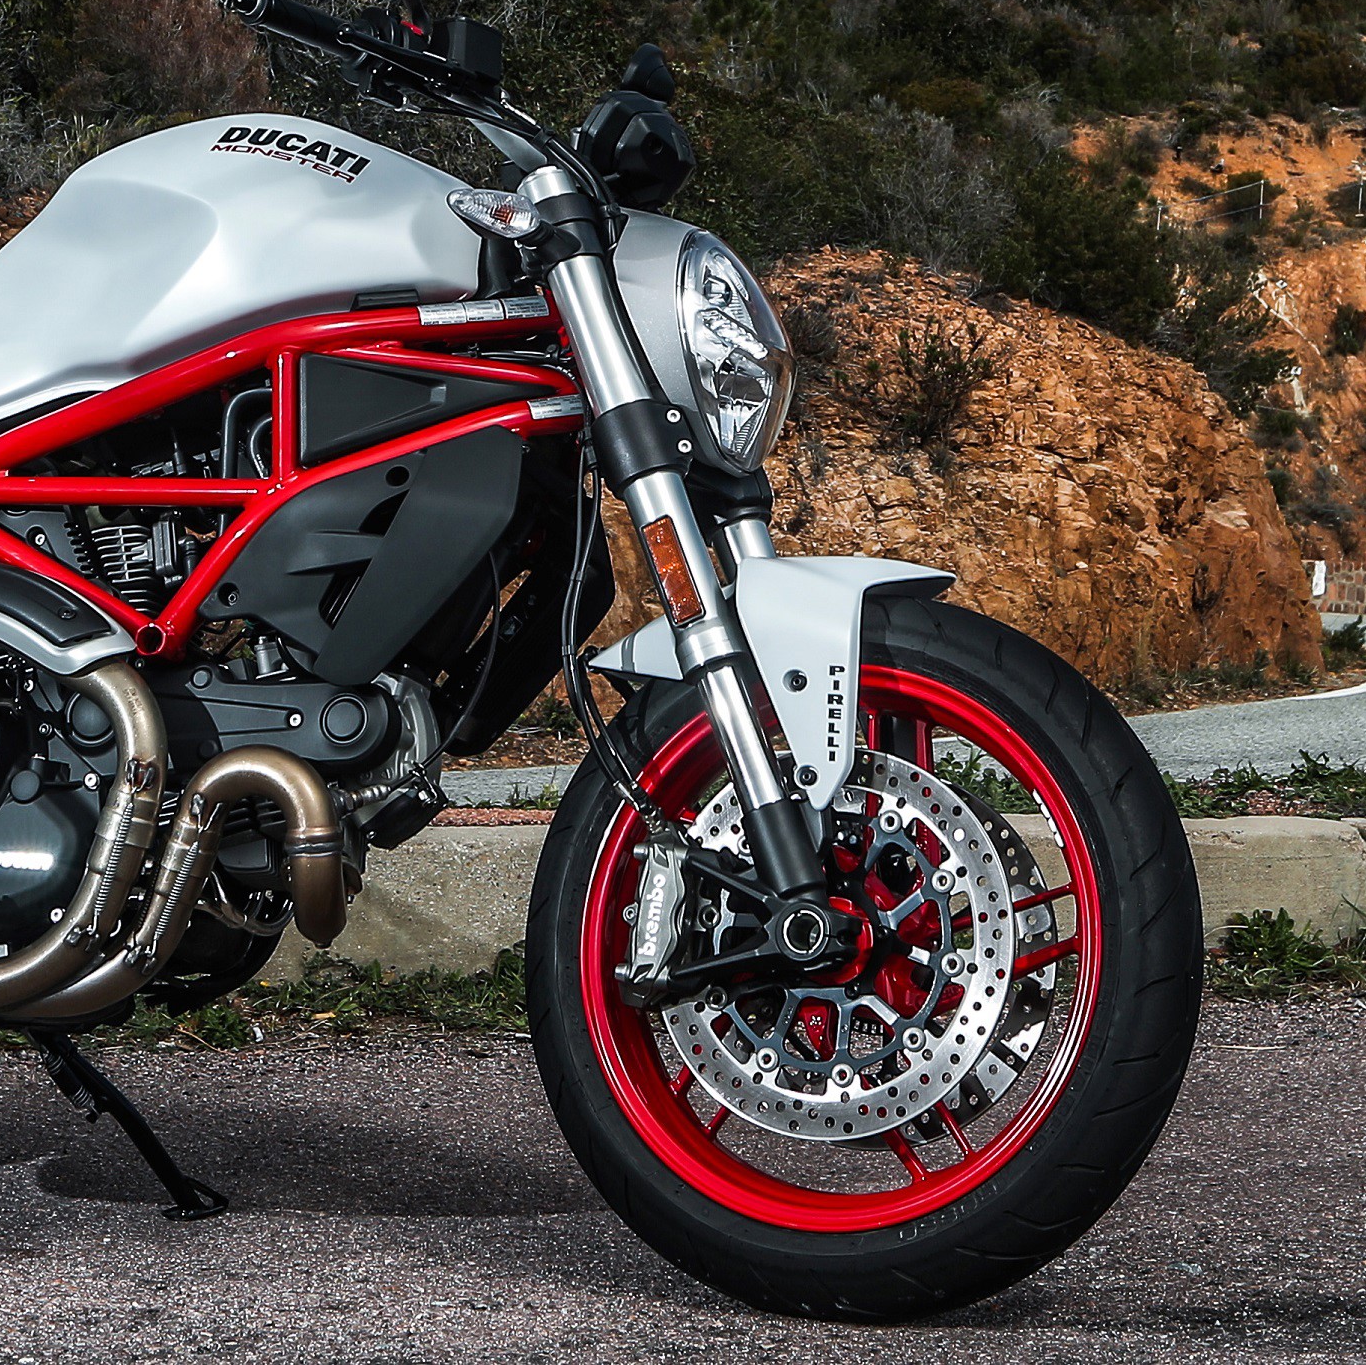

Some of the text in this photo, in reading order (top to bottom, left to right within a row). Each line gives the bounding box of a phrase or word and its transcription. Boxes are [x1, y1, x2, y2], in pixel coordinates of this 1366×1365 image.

[210, 144, 356, 184] MONSTER
[217, 126, 371, 177] DUCATI
[827, 664, 845, 763] PIRELLI
[637, 872, 667, 958] brembo
